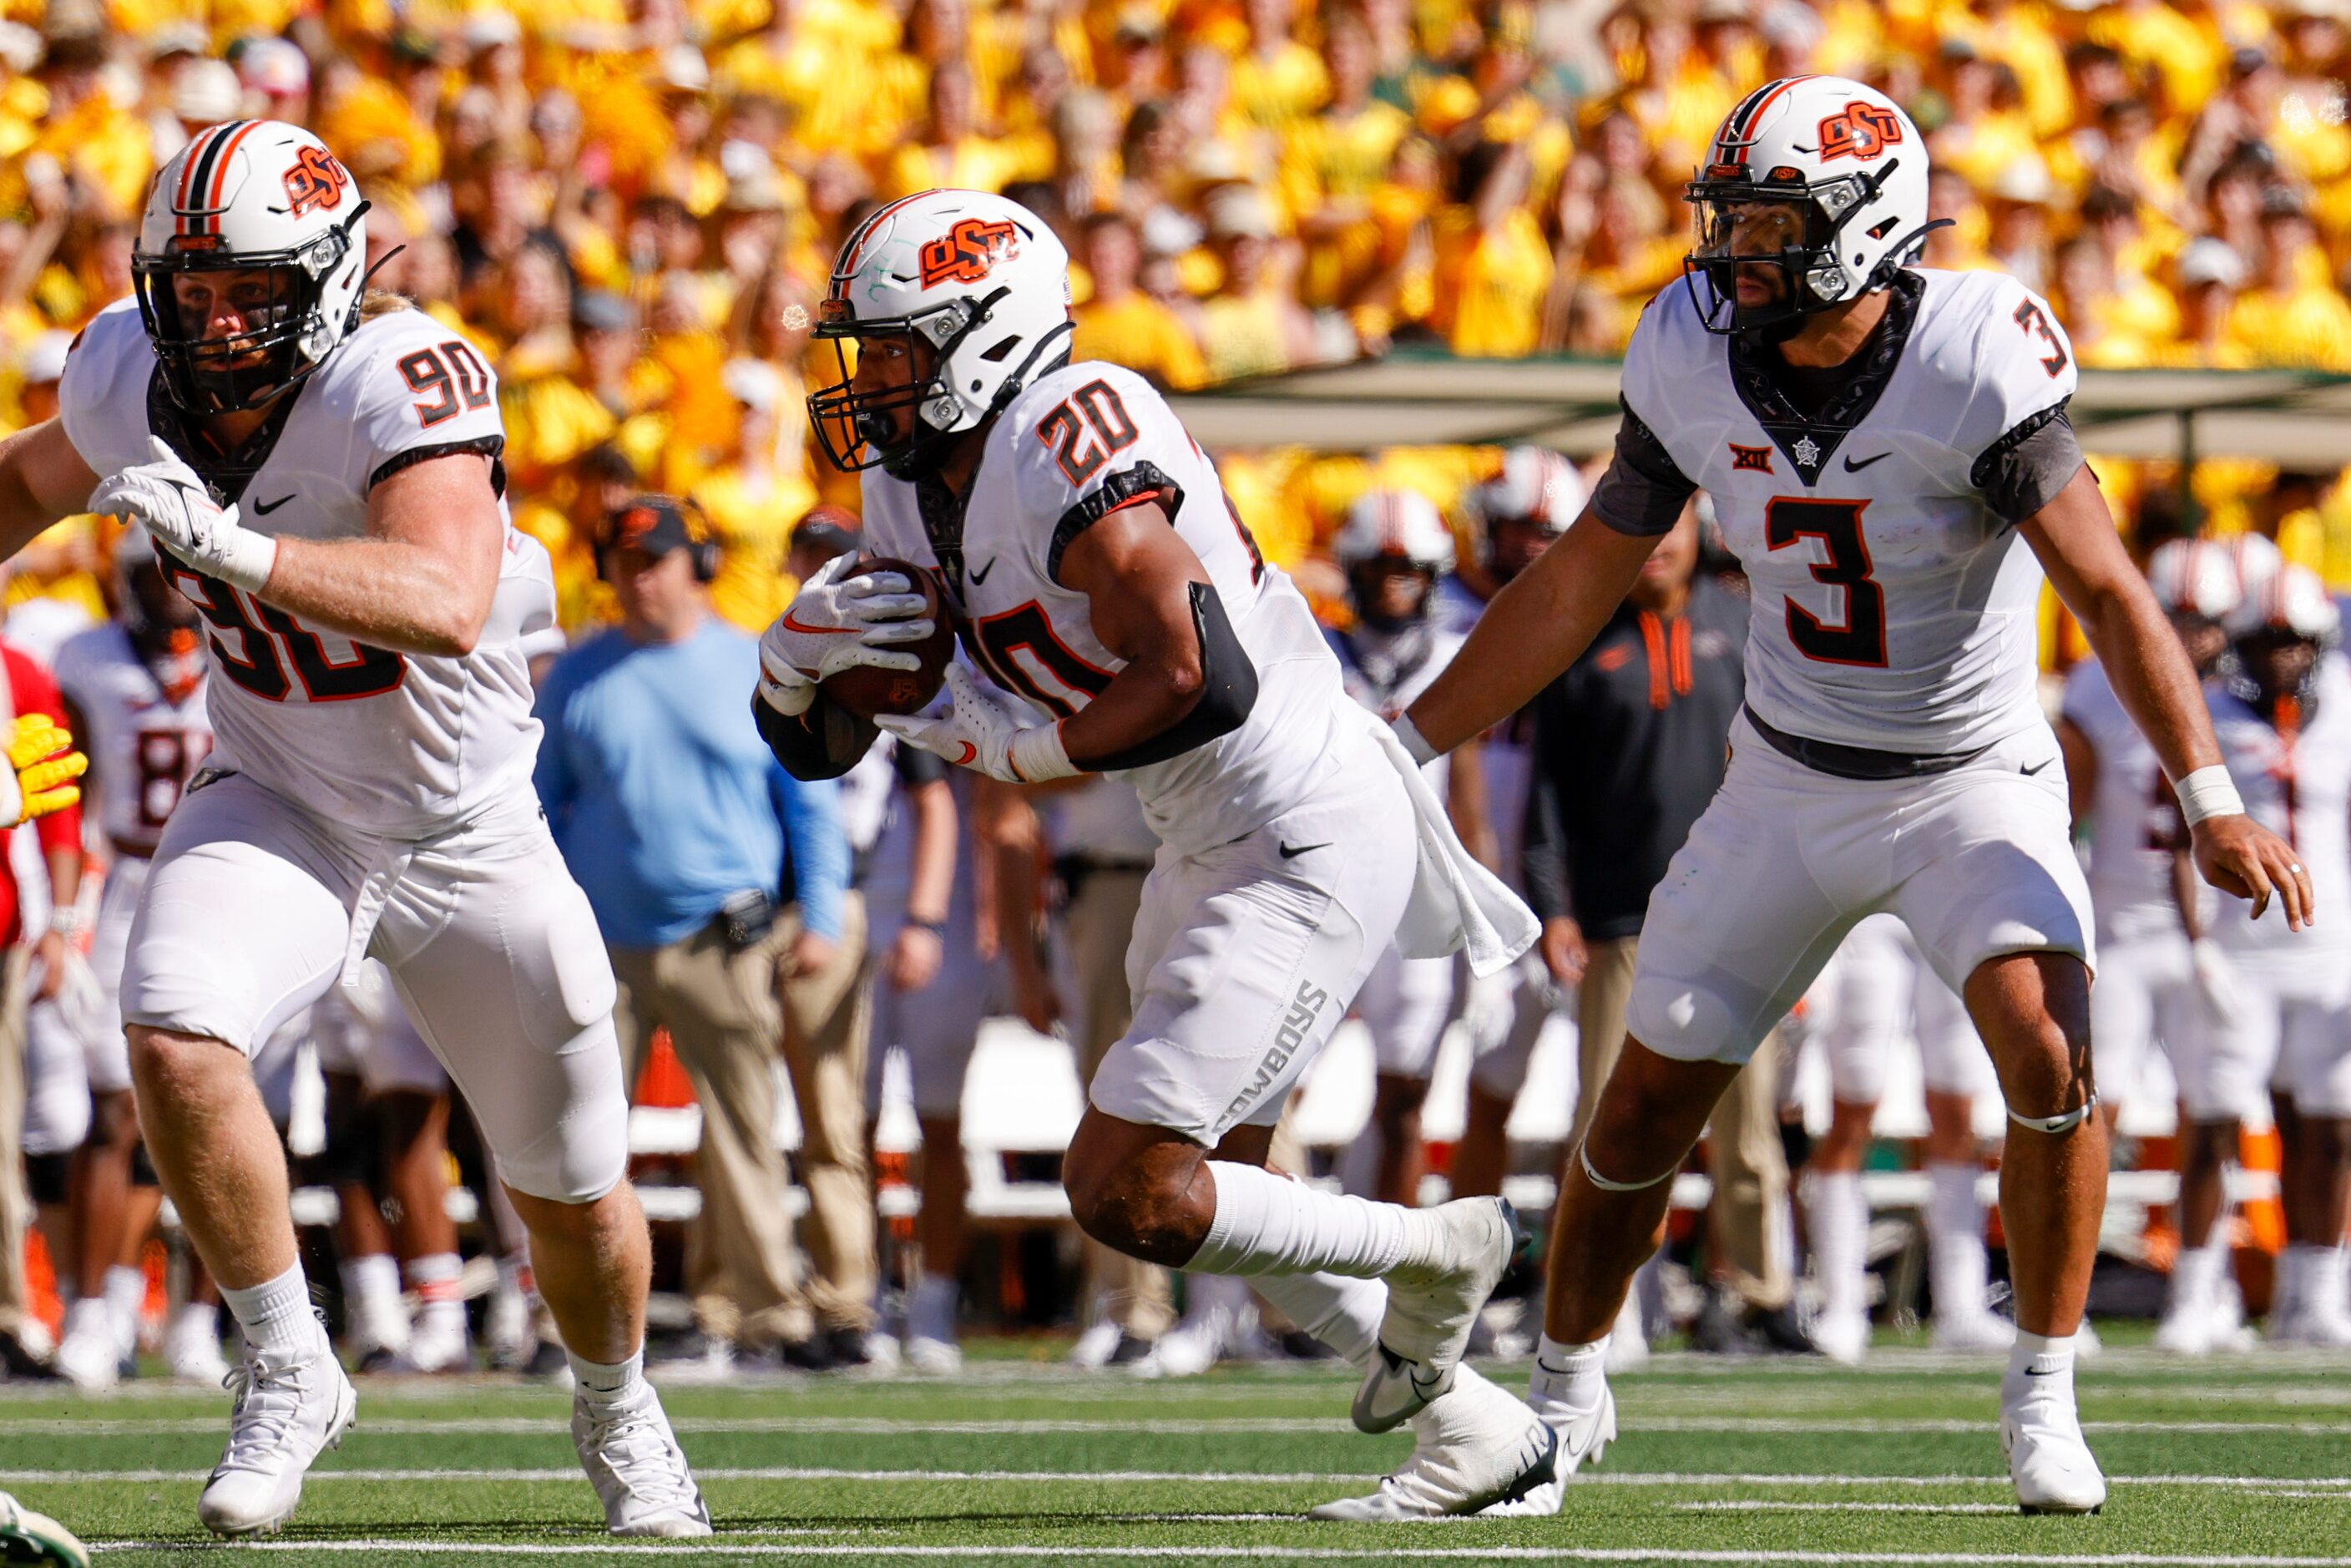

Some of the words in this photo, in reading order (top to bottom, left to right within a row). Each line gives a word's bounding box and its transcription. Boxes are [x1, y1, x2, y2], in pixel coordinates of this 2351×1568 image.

[1818, 100, 1903, 164] OSU
[281, 144, 348, 221] OSU
[918, 218, 1019, 292] OSU
[2013, 296, 2068, 379] 3
[396, 341, 491, 428] 90
[1036, 378, 1139, 488] 20
[1727, 442, 1775, 476] XII
[1765, 495, 1888, 668] 3
[1211, 979, 1327, 1134] COWBOYS
